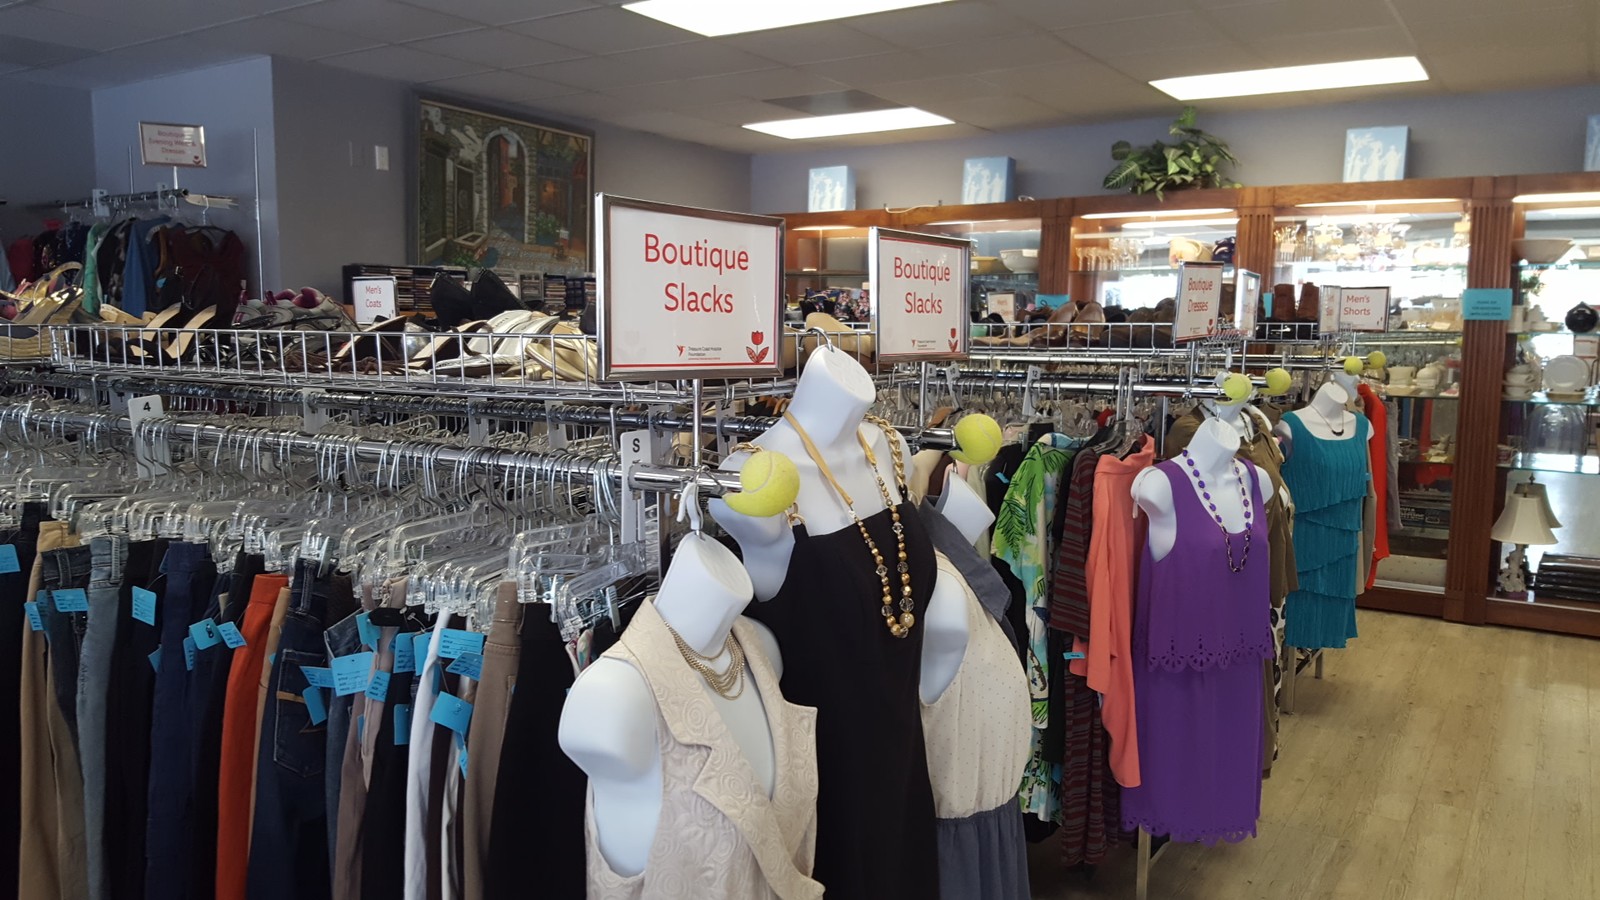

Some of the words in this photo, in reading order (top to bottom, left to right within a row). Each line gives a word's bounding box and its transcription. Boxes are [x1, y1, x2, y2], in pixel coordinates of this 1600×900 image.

[645, 233, 749, 275] Boutique
[894, 256, 951, 285] Boutique
[366, 285, 382, 294] Men's
[1188, 277, 1213, 293] Boutique
[365, 298, 382, 307] Coats
[664, 282, 734, 313] Slacks
[905, 291, 943, 314] Slacks
[1346, 295, 1371, 303] Men's
[1188, 299, 1209, 312] Dresses
[1343, 307, 1371, 315] Shorts
[143, 402, 151, 412] 4
[632, 438, 640, 453] S
